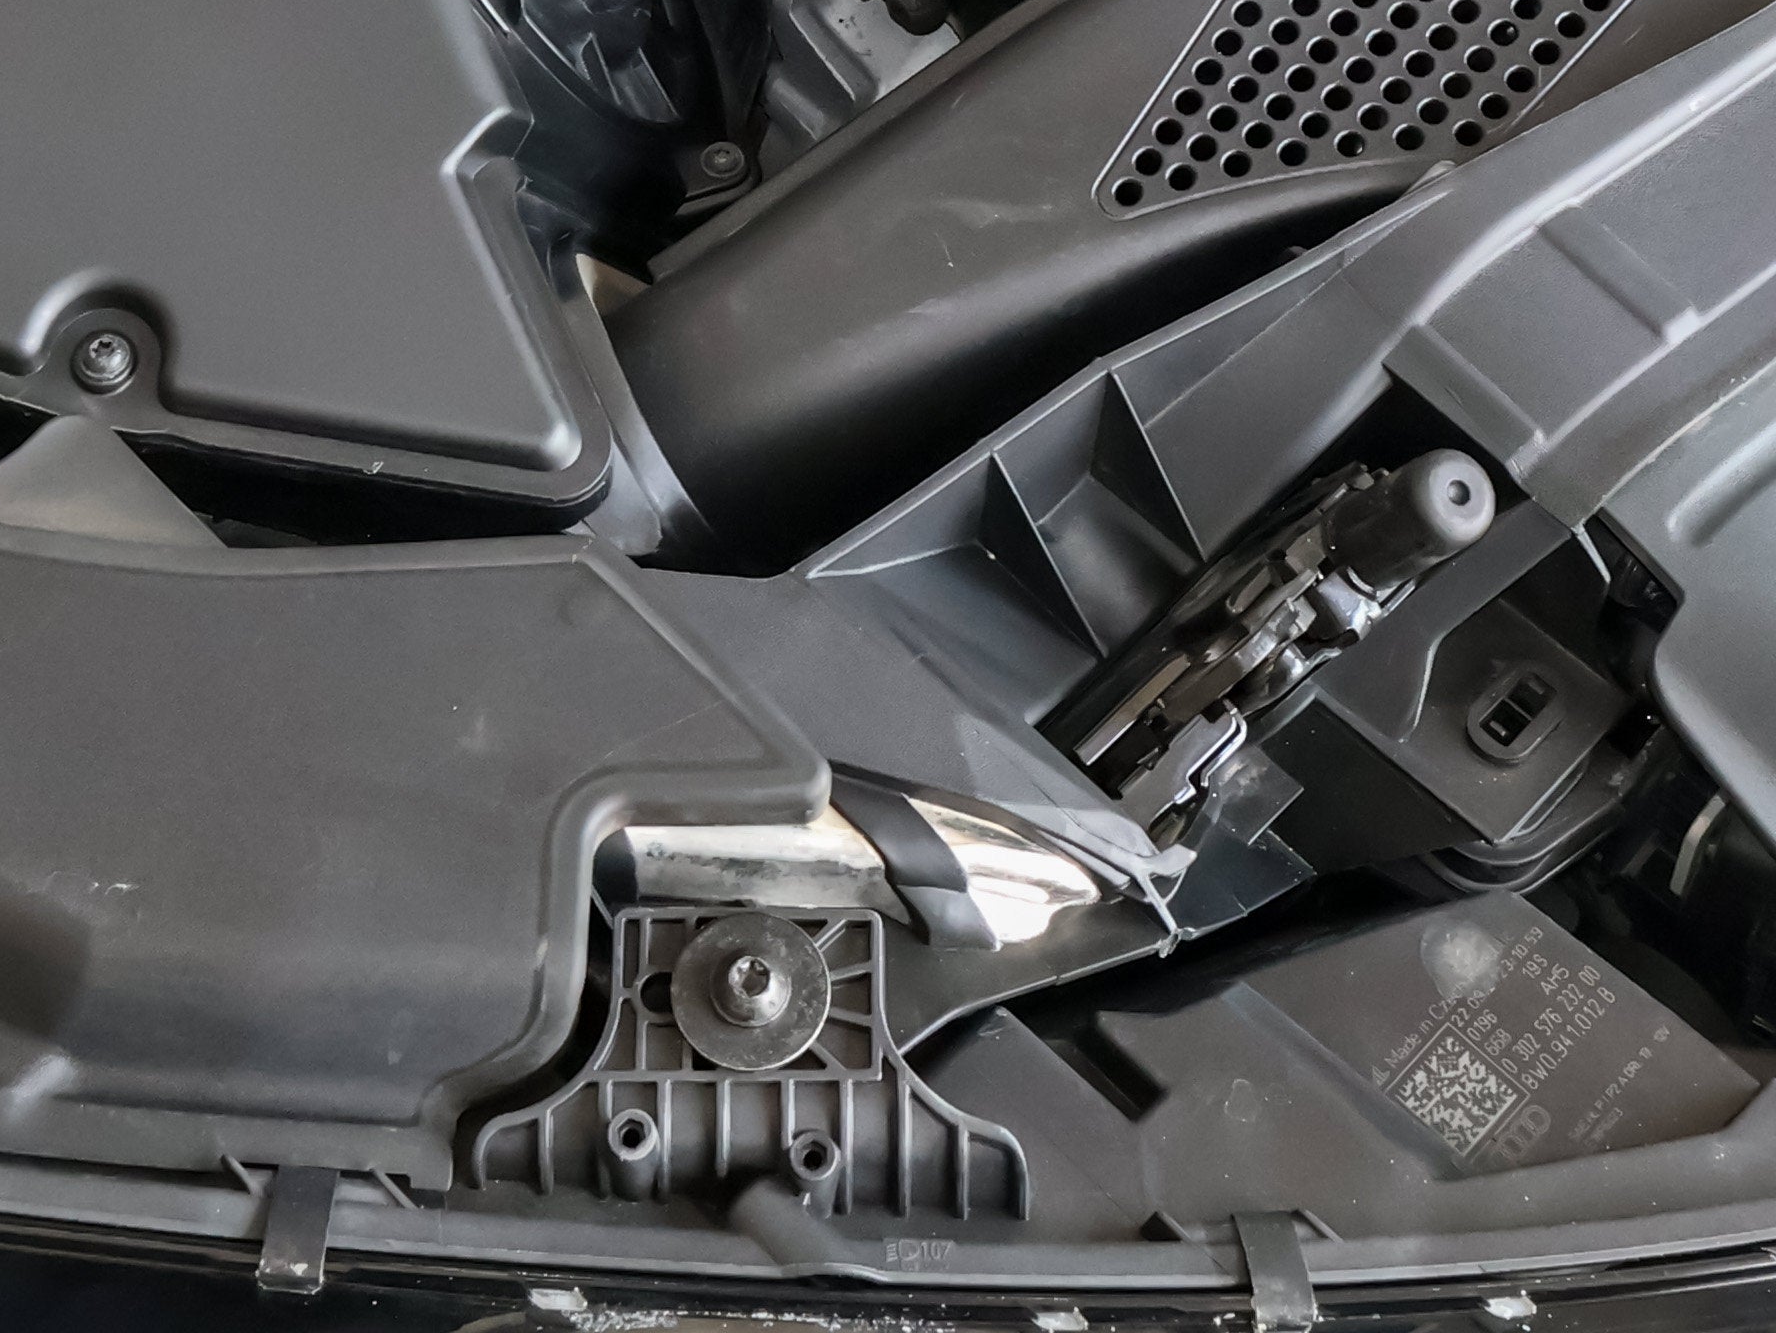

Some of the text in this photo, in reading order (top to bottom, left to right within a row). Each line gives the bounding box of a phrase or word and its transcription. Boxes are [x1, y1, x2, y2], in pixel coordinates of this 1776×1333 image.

[1384, 1032, 1422, 1068] Made
[1419, 1019, 1434, 1034] in
[1466, 1009, 1498, 1041] 0196
[1501, 965, 1602, 1074] 0 302 576 232 00
